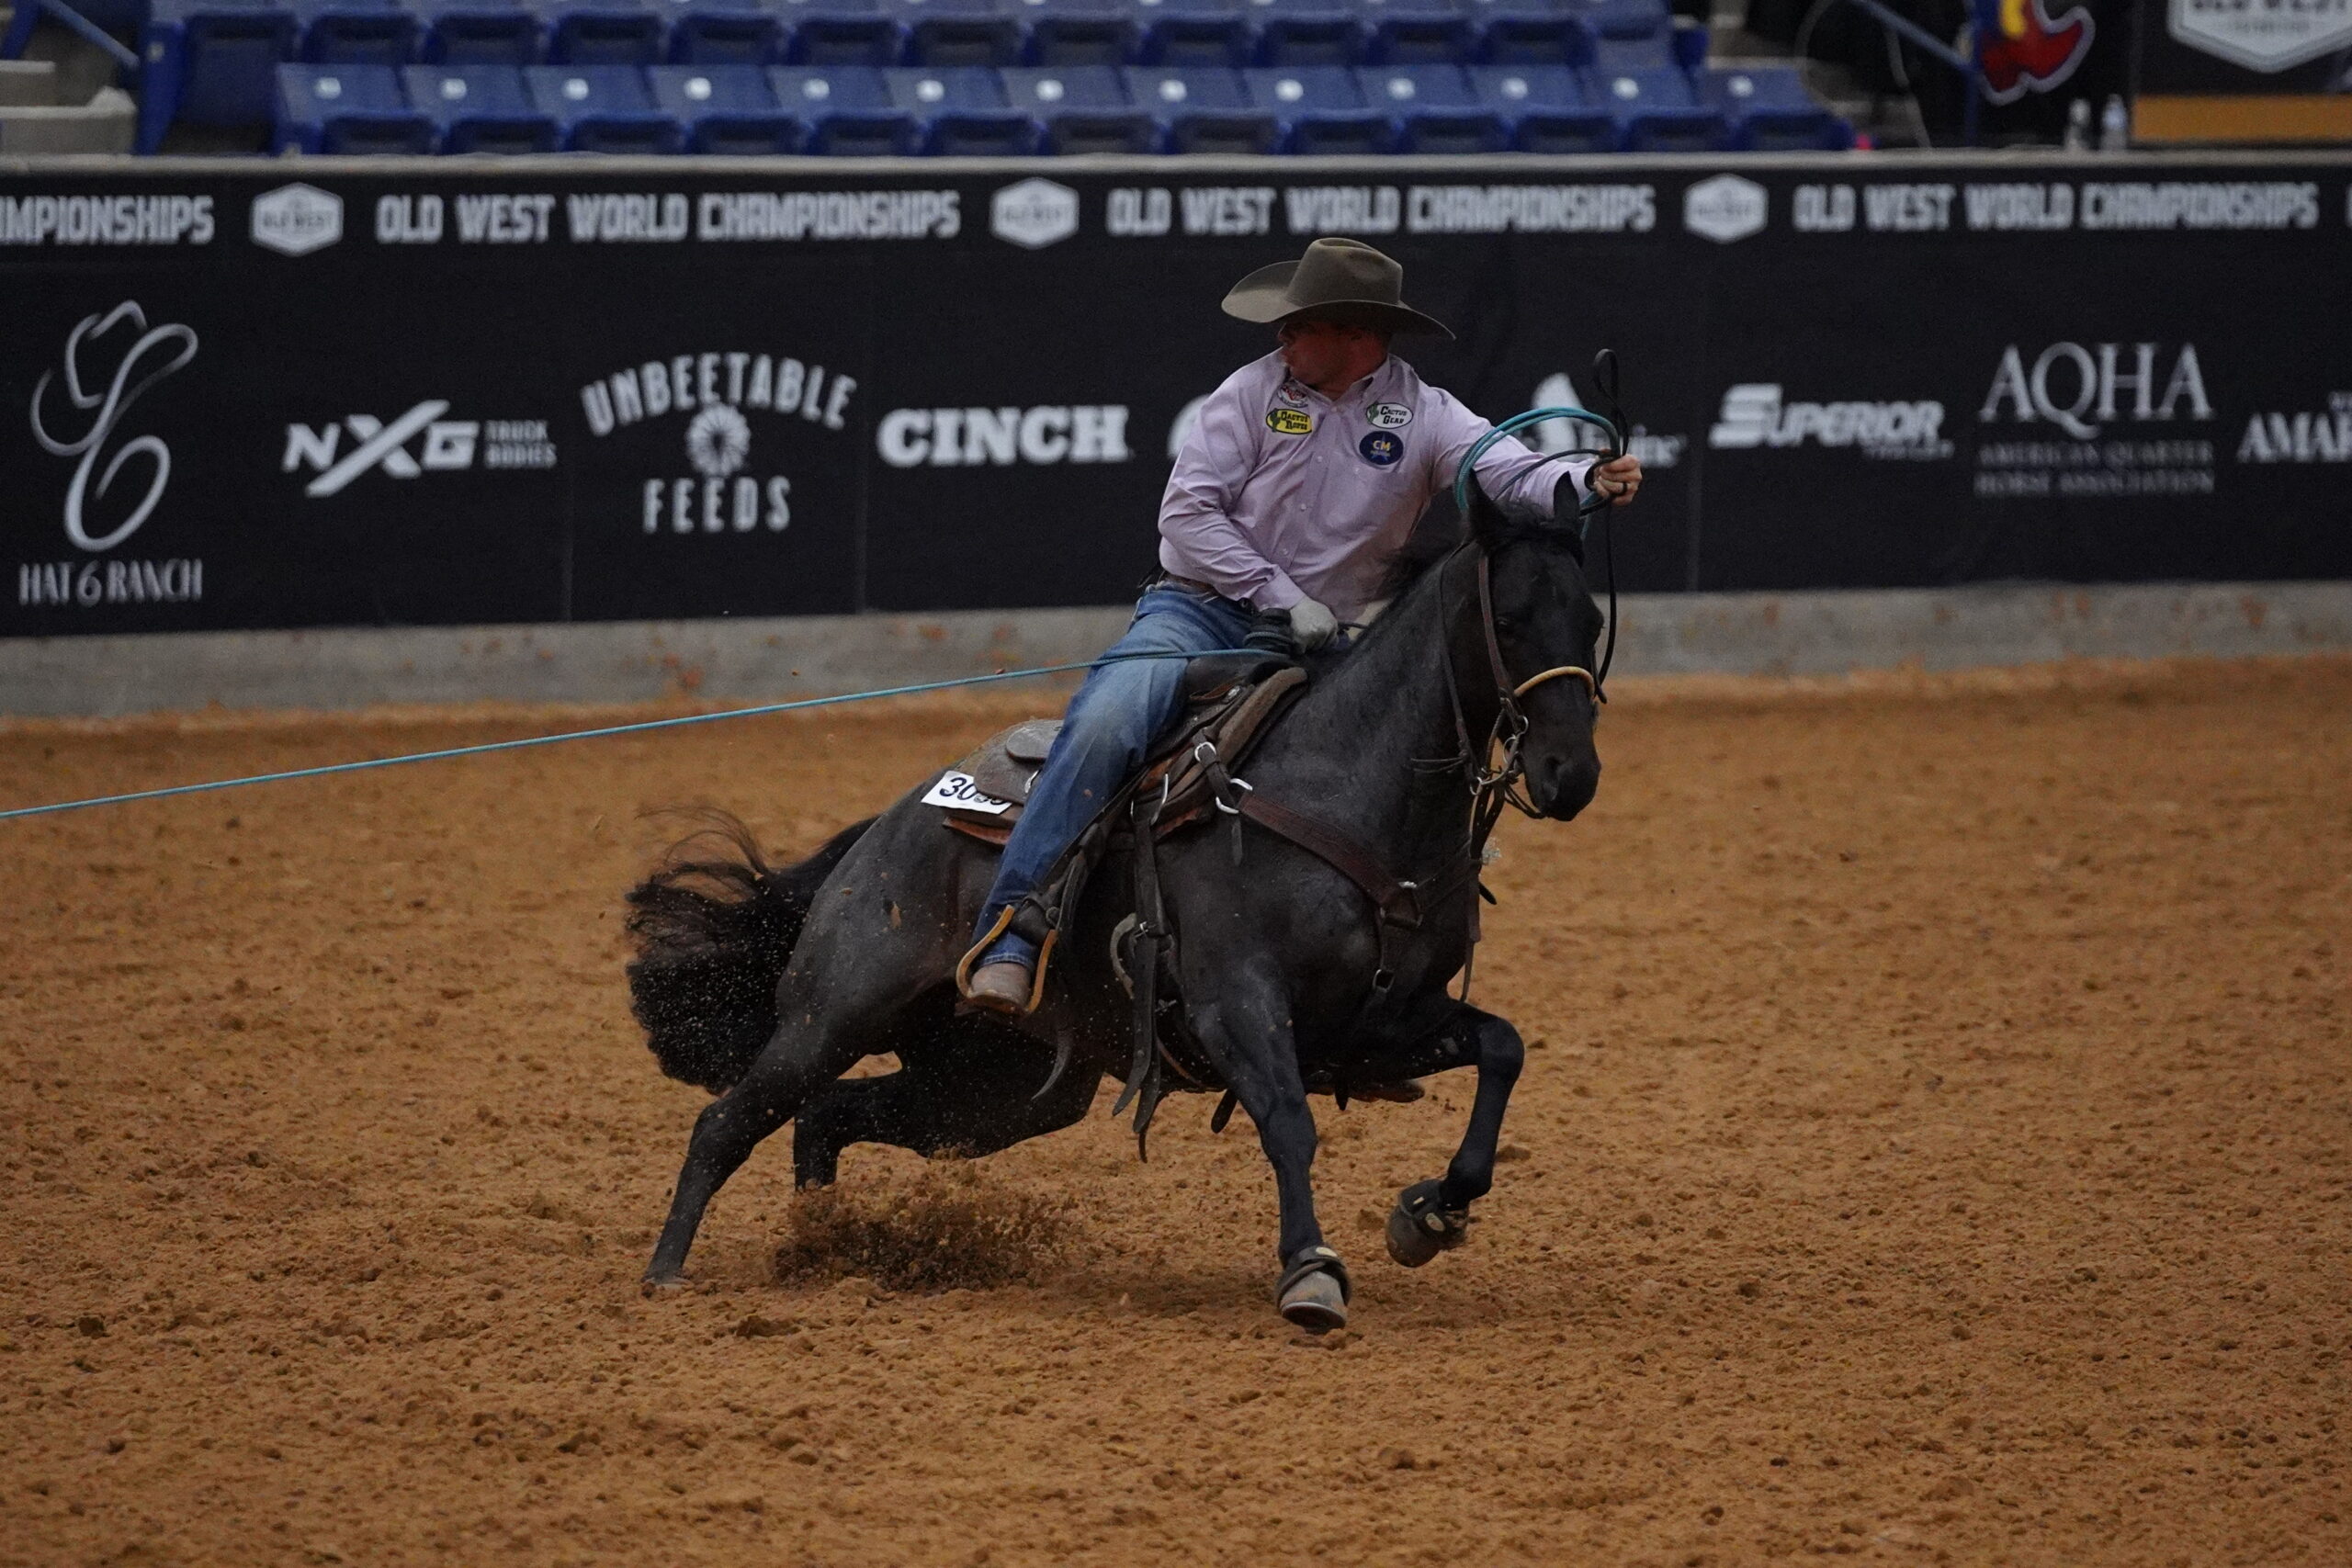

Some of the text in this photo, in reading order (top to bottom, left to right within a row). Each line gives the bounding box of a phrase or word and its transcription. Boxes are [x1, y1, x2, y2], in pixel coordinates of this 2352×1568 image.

[375, 194, 444, 243] OLD
[454, 193, 557, 243] WEST
[567, 192, 689, 243] WORLD
[696, 190, 961, 242] CHAMPIONSHIPS
[1105, 186, 1172, 236] OLD
[1179, 186, 1276, 236] WEST
[1284, 185, 1402, 234] WORLD
[1406, 184, 1656, 233] CHAMPIONSHIPS
[1792, 182, 2319, 232] OLD WEST WORLD CHAMPIONSHIPS
[581, 352, 857, 437] UNBEETABLE
[1977, 342, 2215, 440] AQHA
[876, 404, 1129, 467] CINCH
[1383, 415, 1405, 424] GEAR
[281, 399, 480, 497] NXG
[643, 476, 791, 534] FEEDS
[18, 558, 203, 607] HAT 6 RANCH
